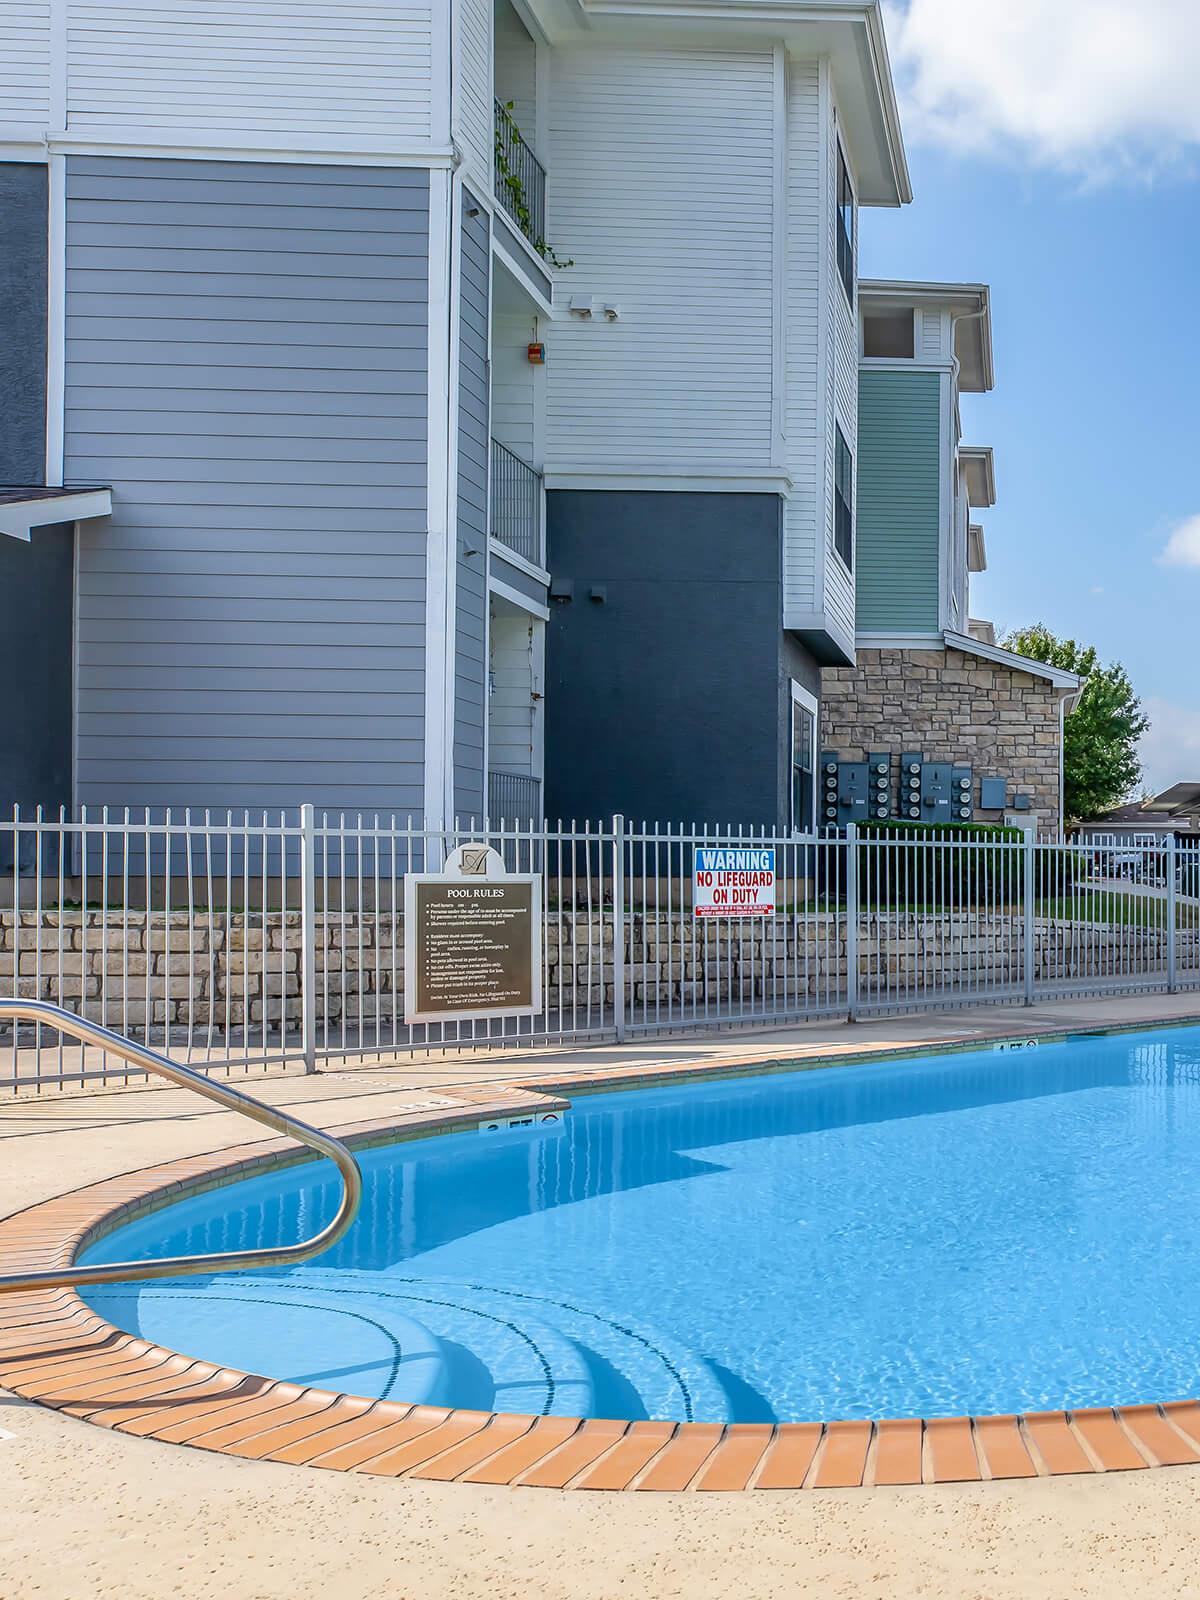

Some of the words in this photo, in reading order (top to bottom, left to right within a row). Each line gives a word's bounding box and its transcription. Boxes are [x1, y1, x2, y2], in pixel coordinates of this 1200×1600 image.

[701, 851, 769, 870] WARNING
[697, 872, 713, 887] NO
[717, 872, 773, 887] LIFEGUARD
[447, 889, 473, 898] POOL
[473, 889, 505, 898] RULES
[713, 889, 728, 904] ON
[732, 889, 759, 904] DUTY
